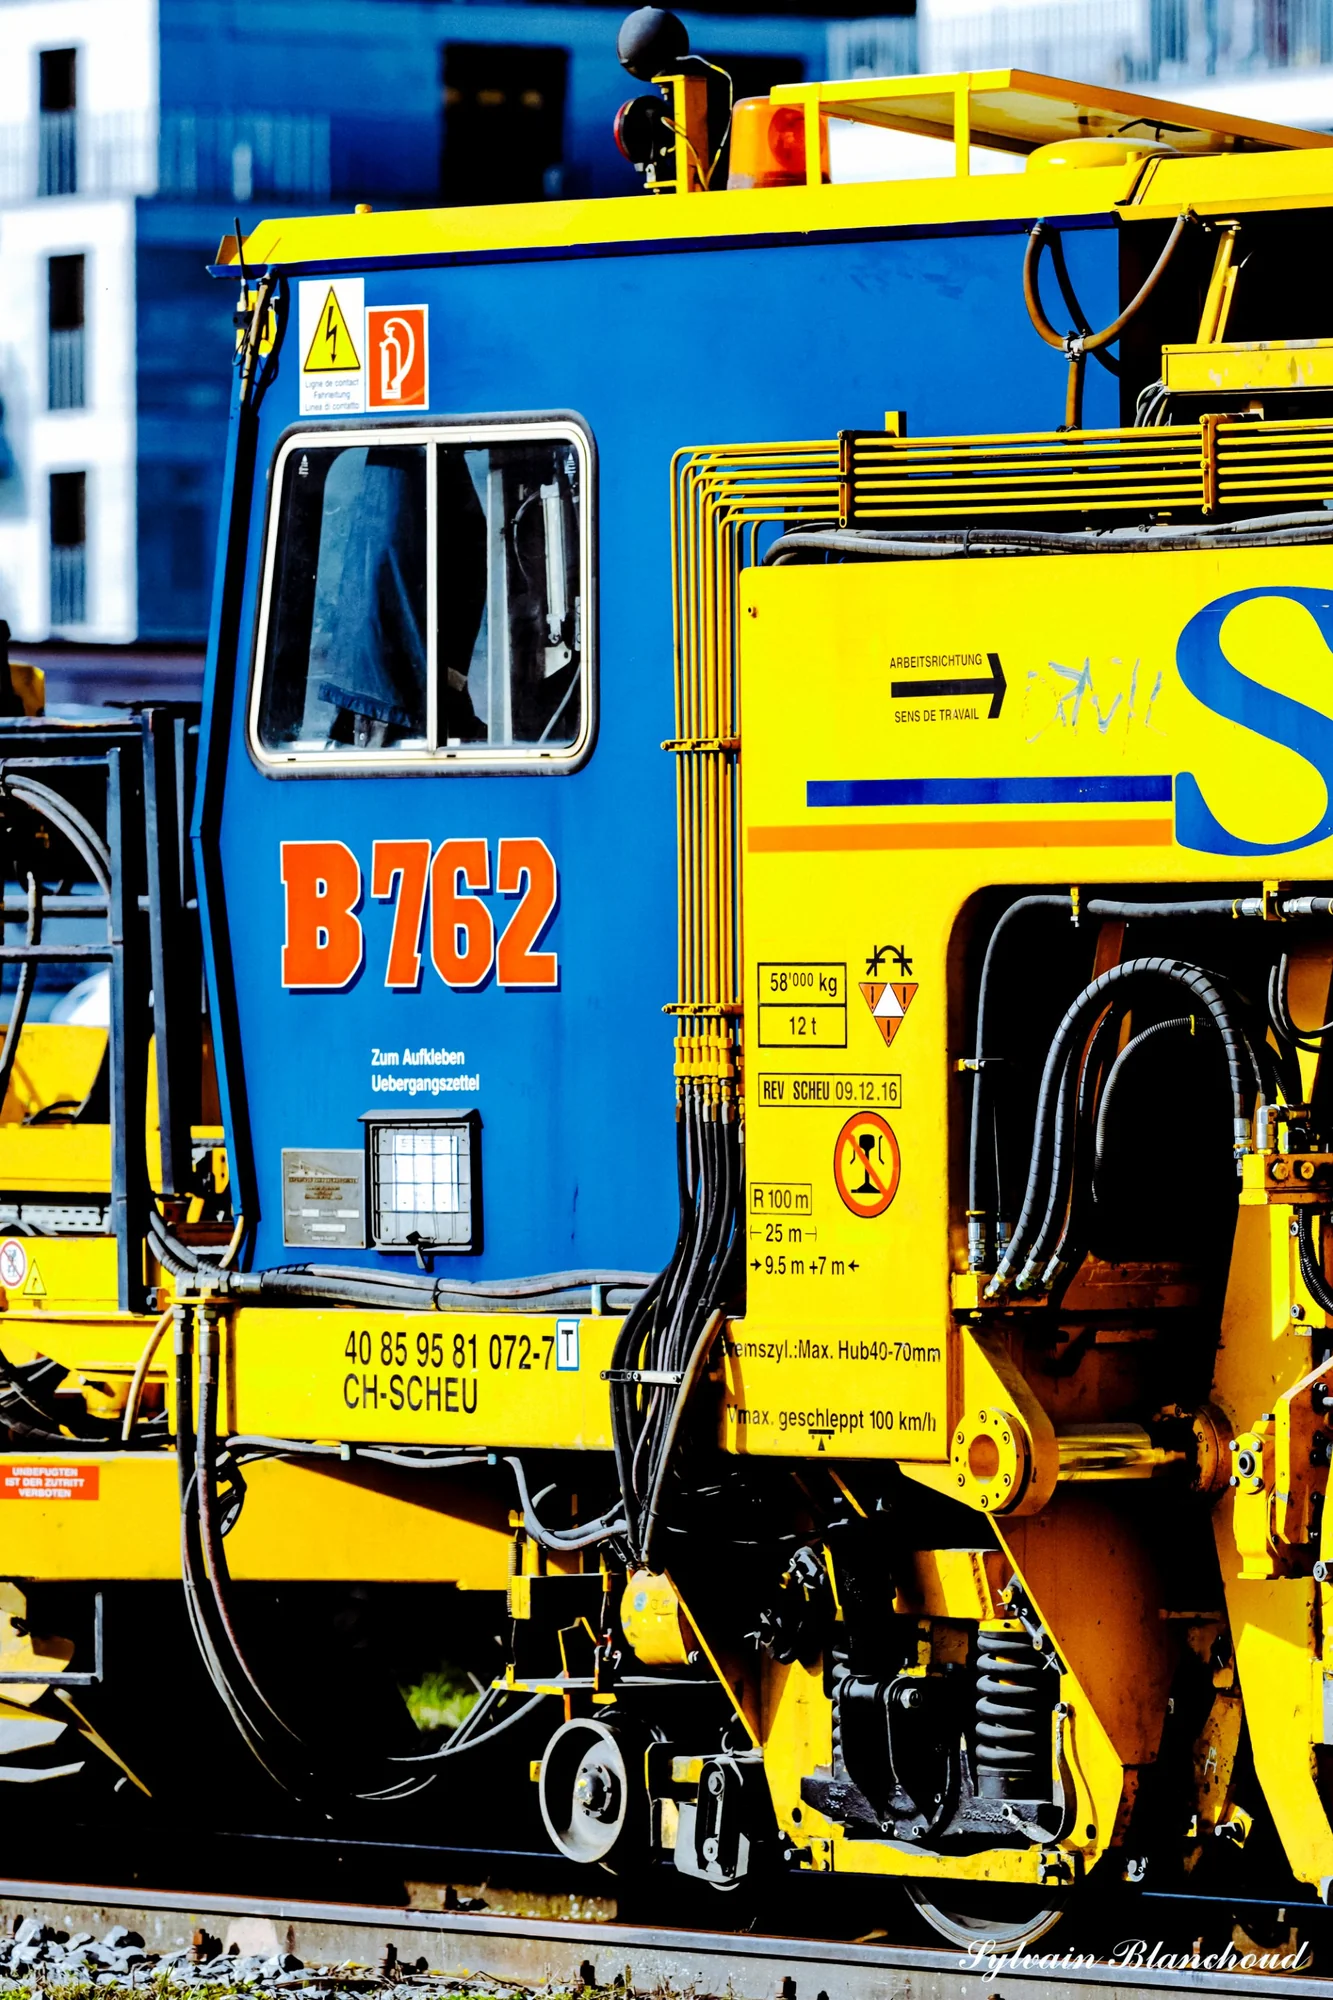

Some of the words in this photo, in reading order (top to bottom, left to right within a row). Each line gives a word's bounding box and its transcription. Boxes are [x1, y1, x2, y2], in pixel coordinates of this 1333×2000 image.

[305, 381, 323, 390] Ligne
[335, 379, 359, 387] contact
[889, 653, 983, 669] ARBEITSRICHTUNG
[894, 709, 921, 723] SENS
[923, 709, 936, 722] DE
[939, 708, 980, 721] TRAVAIL
[770, 972, 814, 992] 58'000
[819, 972, 837, 997] kg
[789, 1016, 807, 1035] 12
[811, 1016, 817, 1035] t
[371, 1048, 399, 1066] Zum
[402, 1047, 465, 1066] Aufkleben
[371, 1073, 480, 1096] Uebergangszettel
[763, 1080, 785, 1100] REV
[793, 1080, 830, 1101] SCHEU
[835, 1081, 898, 1102] 09.12.16
[753, 1188, 764, 1208] R
[768, 1189, 792, 1209] 100
[795, 1194, 809, 1209] m
[765, 1223, 783, 1243] 25
[788, 1227, 802, 1243] m
[765, 1255, 786, 1275] 9.5
[791, 1259, 804, 1275] m
[809, 1256, 827, 1275] +7
[831, 1260, 845, 1275] m
[344, 1330, 372, 1366] 40
[380, 1331, 408, 1367] 85
[416, 1332, 444, 1368] 95
[452, 1333, 477, 1369] 81
[489, 1334, 555, 1370] 072-7
[561, 1329, 574, 1361] T
[343, 1373, 478, 1414] CH-SCHEU
[727, 1403, 774, 1425] Vmax.
[778, 1408, 864, 1433] geschleppt
[869, 1410, 893, 1430] 100
[899, 1410, 936, 1432] km/h
[12, 1467, 78, 1477] UNBEFUGTEN
[5, 1477, 21, 1487] IST
[22, 1477, 43, 1487] DER
[44, 1478, 84, 1488] ZUTRITT
[18, 1488, 72, 1498] VERBOTEN
